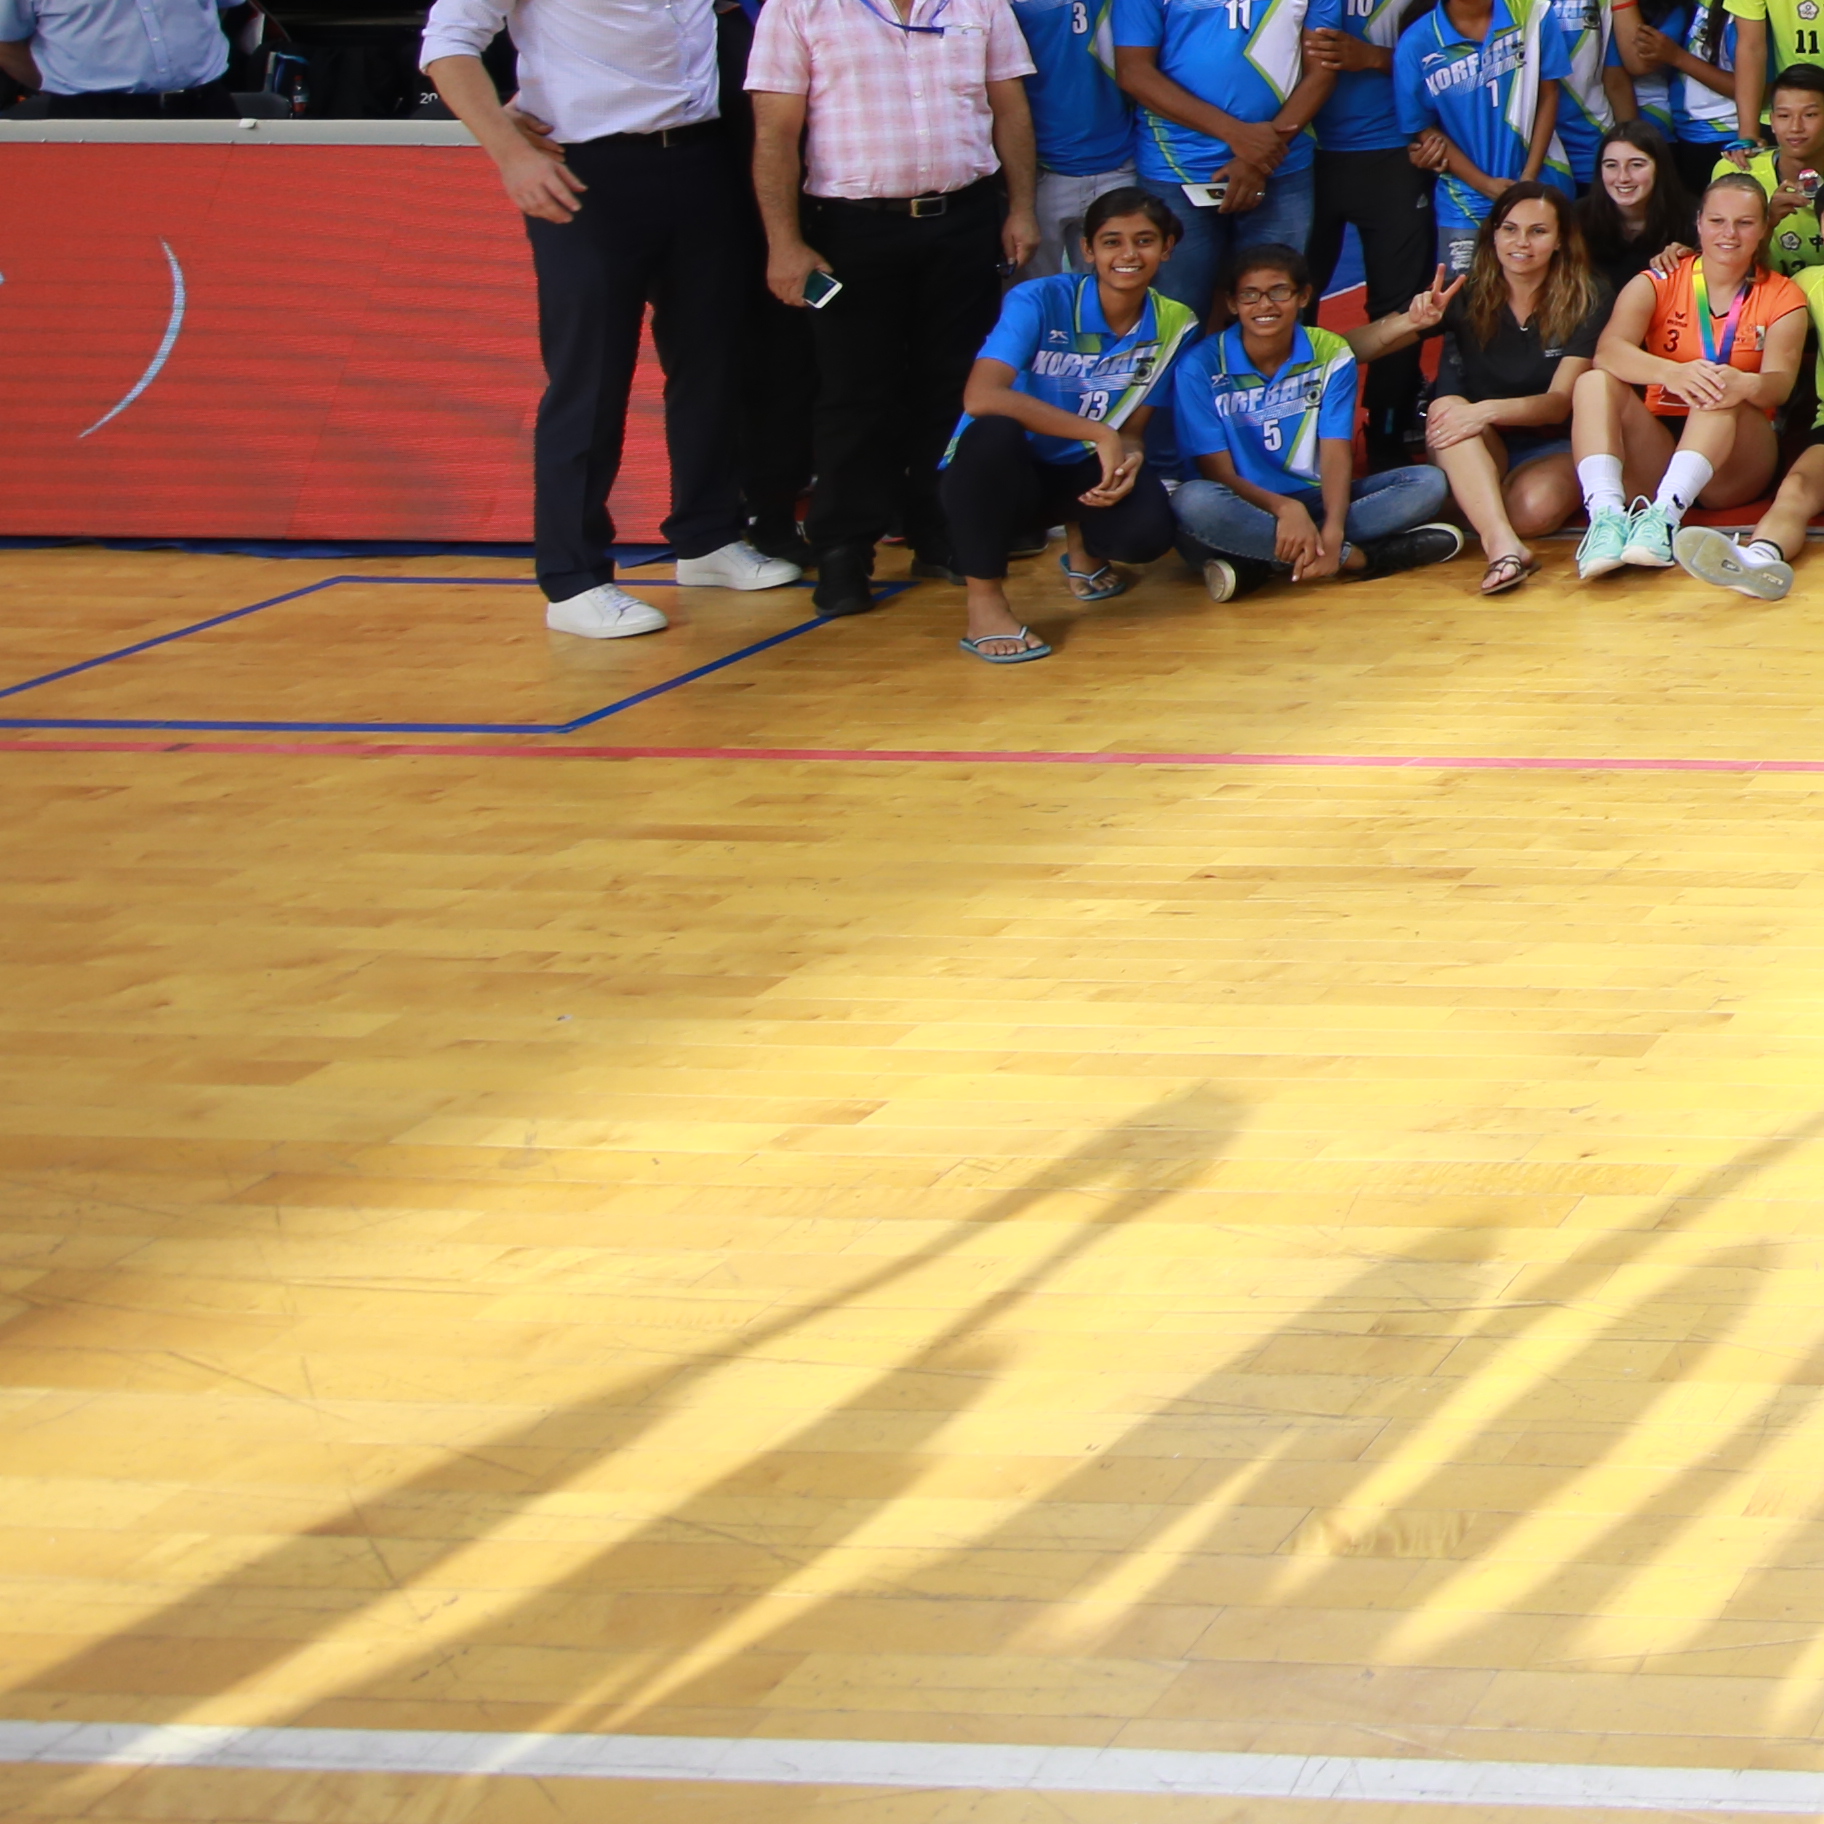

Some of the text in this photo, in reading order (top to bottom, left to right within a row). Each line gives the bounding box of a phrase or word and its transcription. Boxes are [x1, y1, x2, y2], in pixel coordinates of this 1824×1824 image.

[1072, 2, 1088, 35] 3
[1795, 30, 1820, 55] 11
[1663, 329, 1681, 353] 3
[1078, 390, 1110, 422] 13
[1263, 418, 1282, 451] 5
